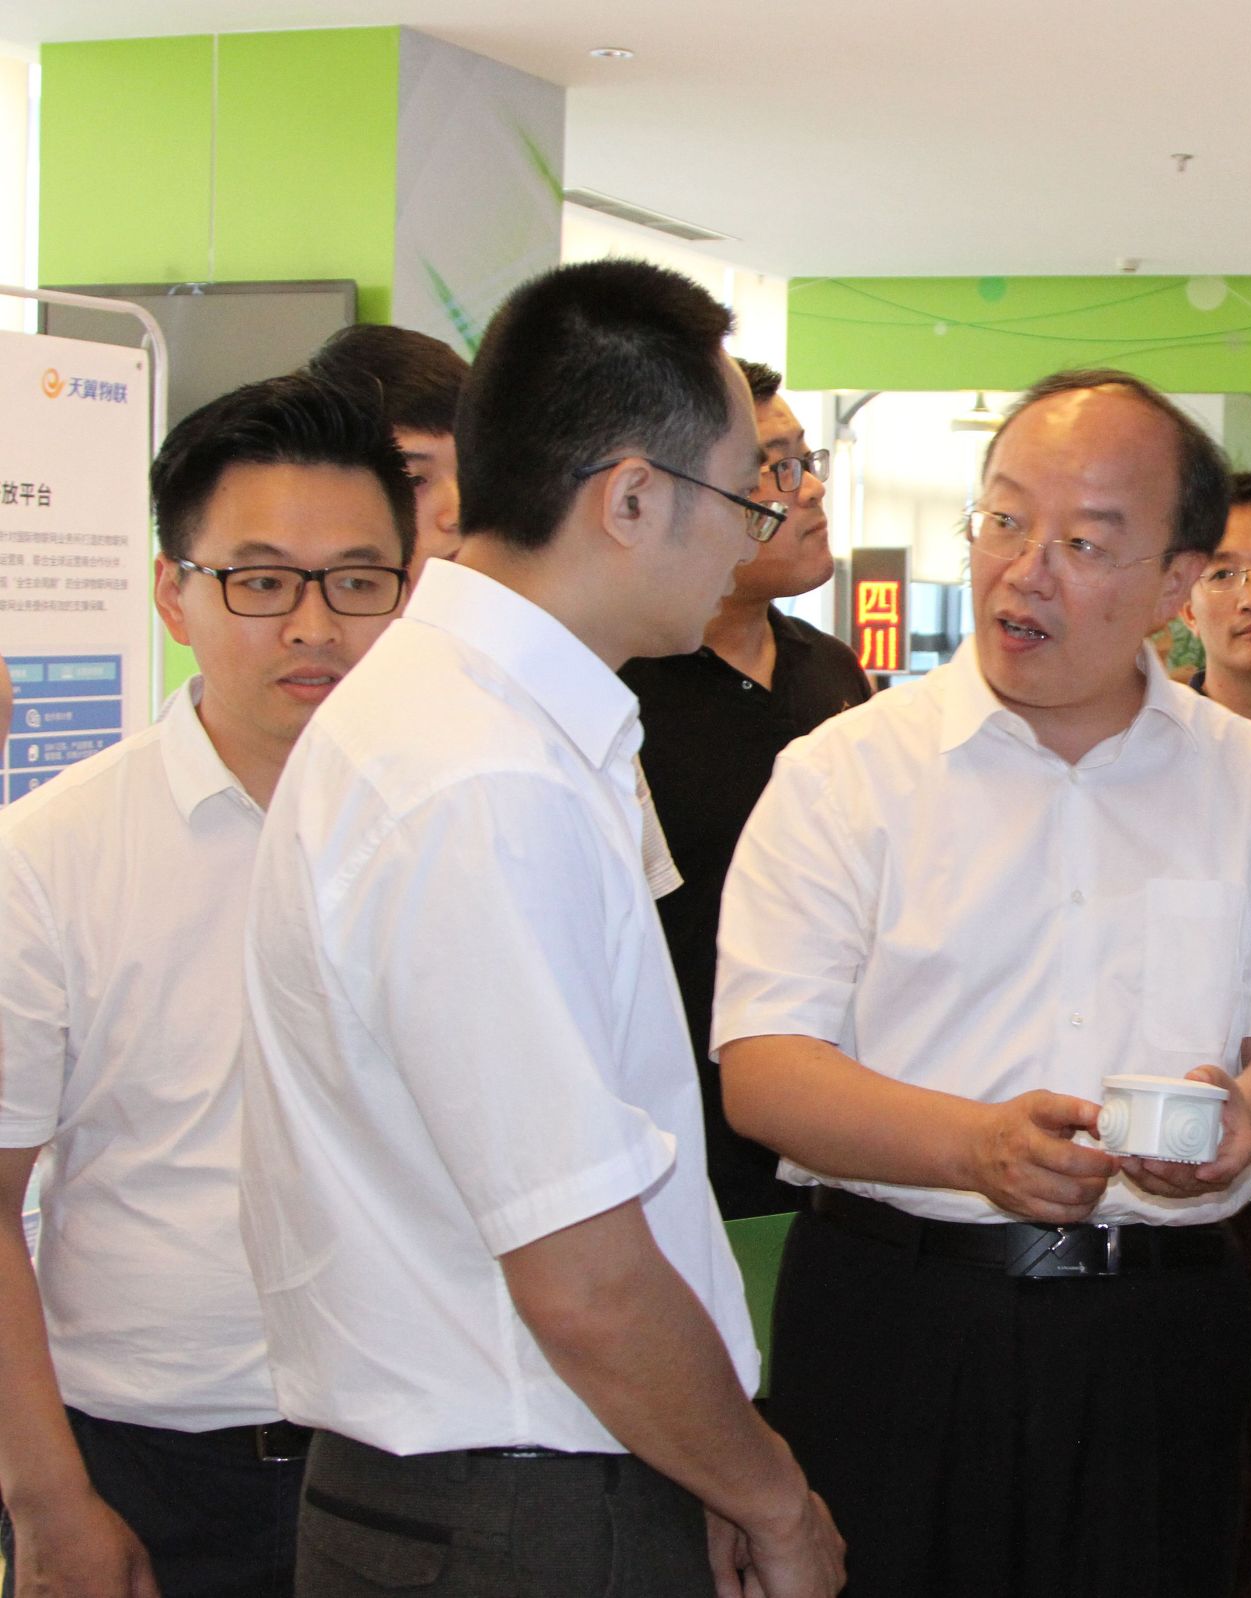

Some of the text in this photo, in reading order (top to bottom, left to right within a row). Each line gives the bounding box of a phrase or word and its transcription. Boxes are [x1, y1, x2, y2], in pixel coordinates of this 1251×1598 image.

[67, 376, 128, 404] 天翼物联
[0, 482, 52, 507] 放平台
[858, 580, 899, 669] 四川
